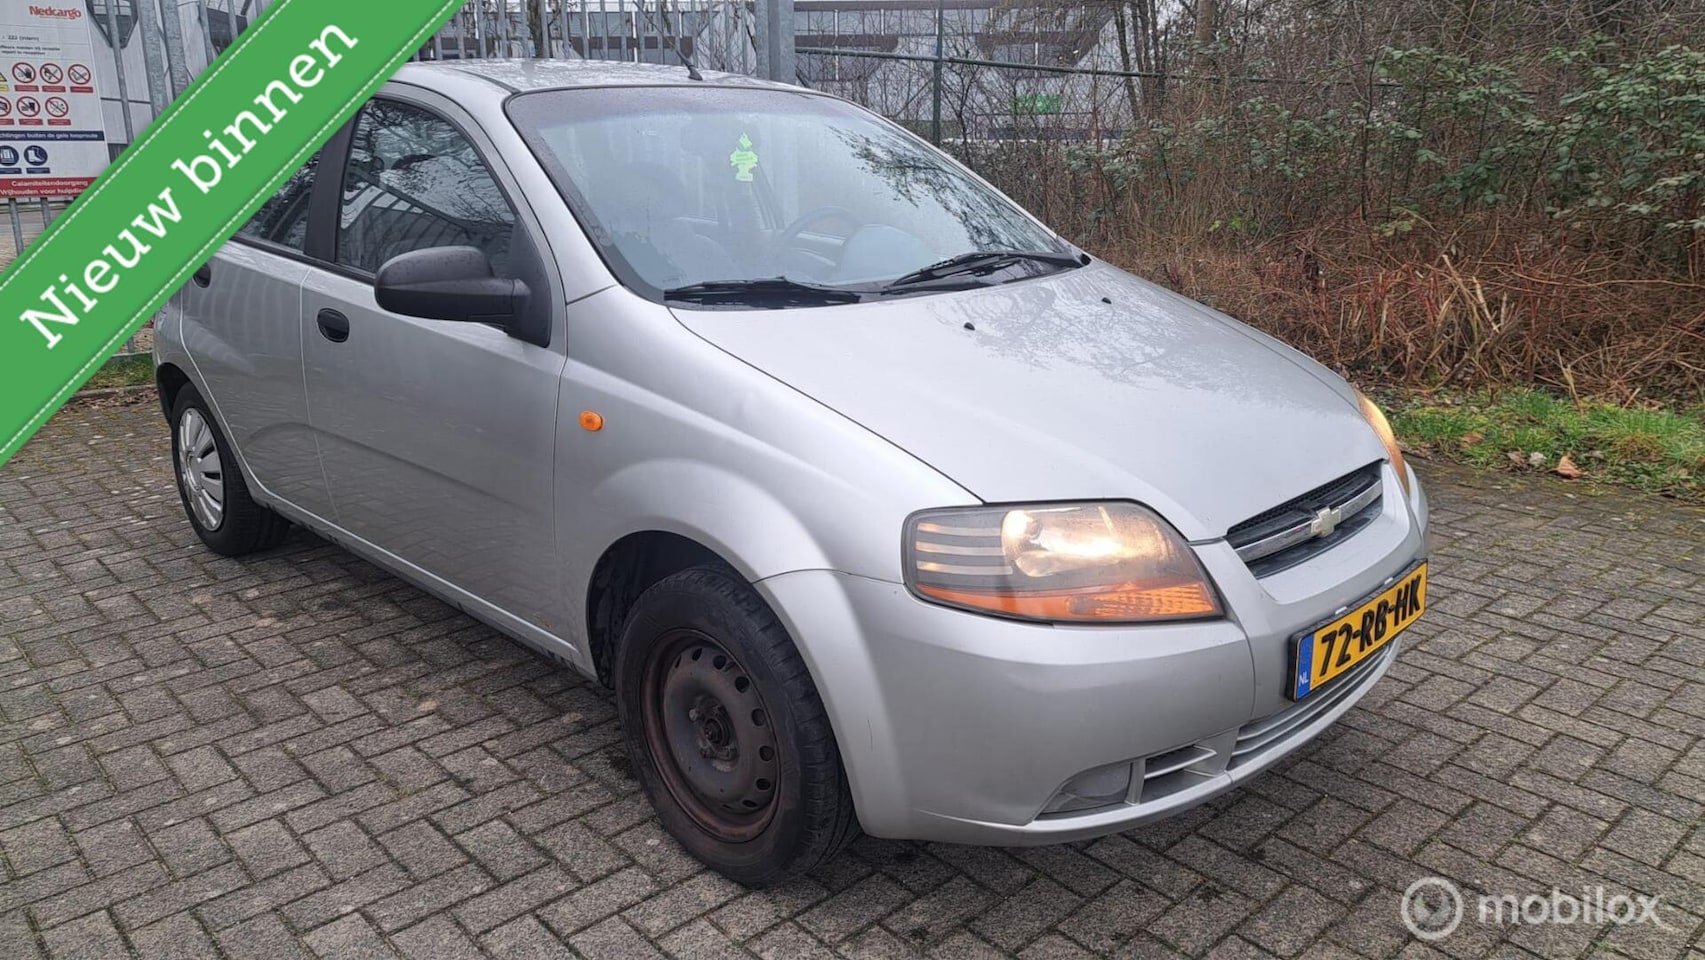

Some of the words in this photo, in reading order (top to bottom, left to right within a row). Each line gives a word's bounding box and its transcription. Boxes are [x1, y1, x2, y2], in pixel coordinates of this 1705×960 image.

[29, 6, 82, 20] Nedcargo
[1319, 574, 1422, 677] 72-RB-HK
[1298, 671, 1310, 687] NL
